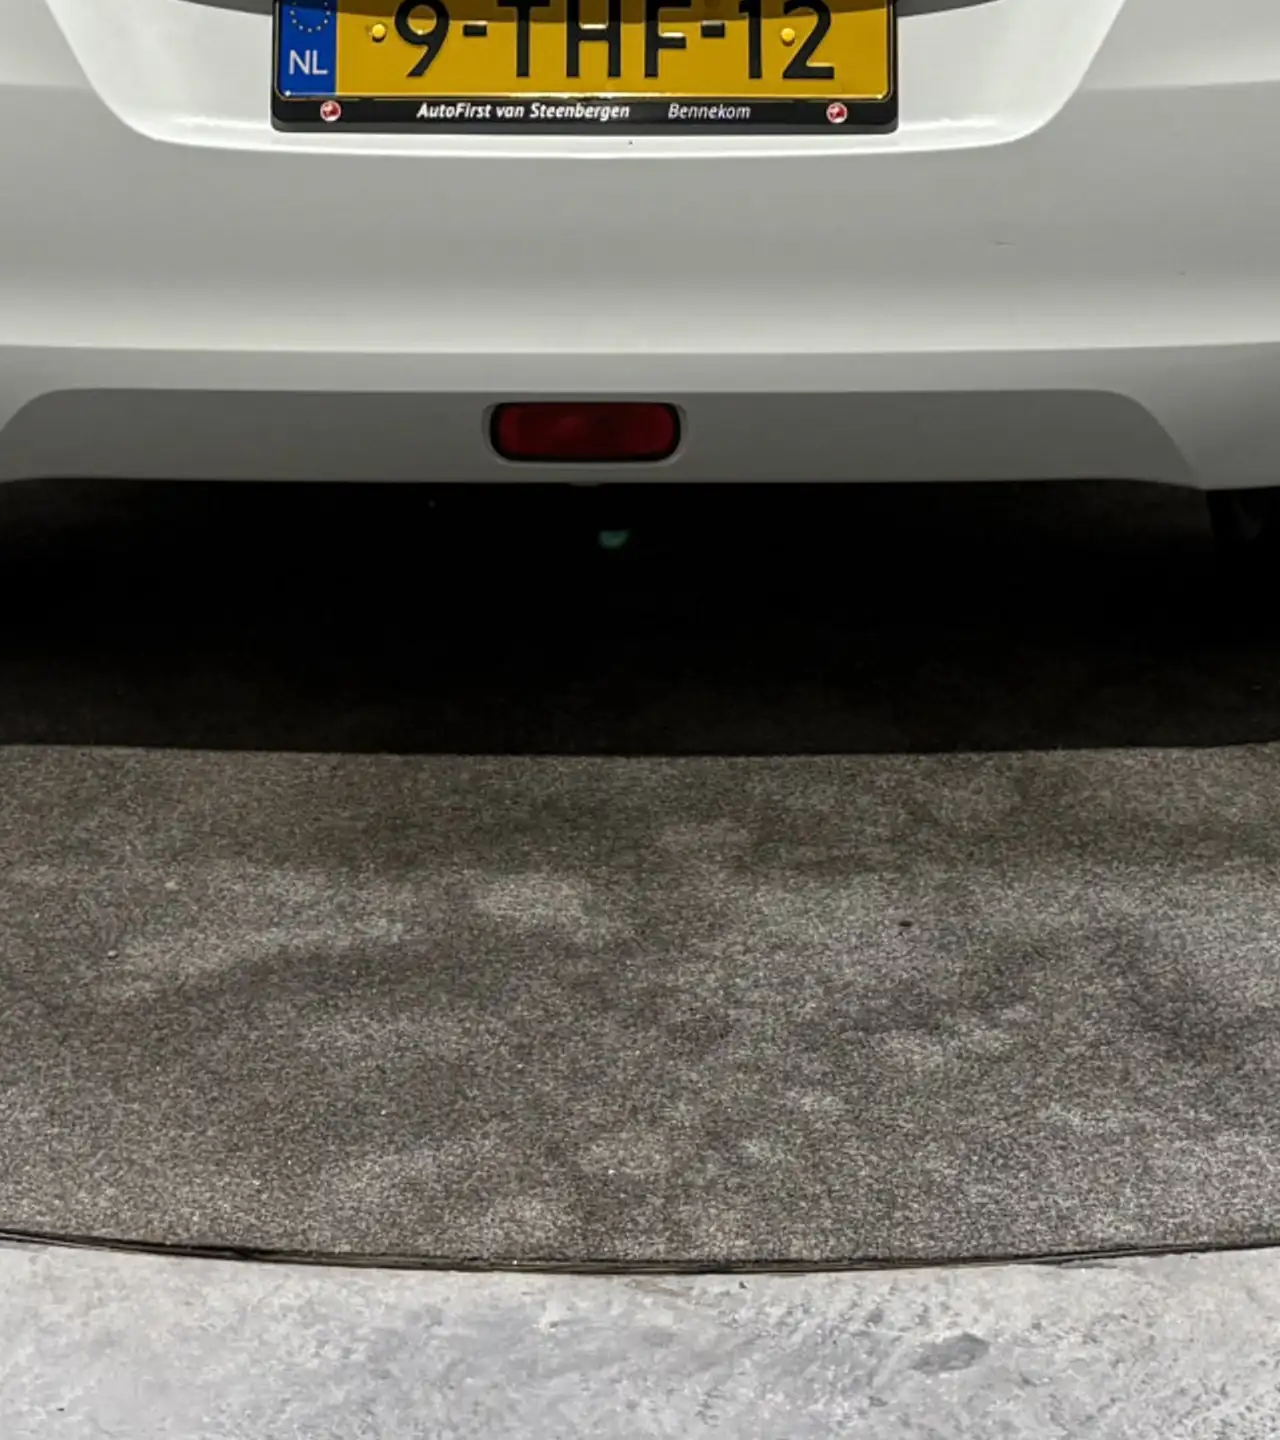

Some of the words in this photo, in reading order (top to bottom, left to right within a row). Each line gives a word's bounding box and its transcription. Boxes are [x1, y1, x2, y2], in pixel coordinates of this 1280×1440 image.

[289, 49, 329, 75] NL
[416, 101, 491, 119] AutoFirst
[496, 105, 525, 119] van
[529, 101, 631, 122] Steenbergen
[667, 102, 752, 120] Bennekom
